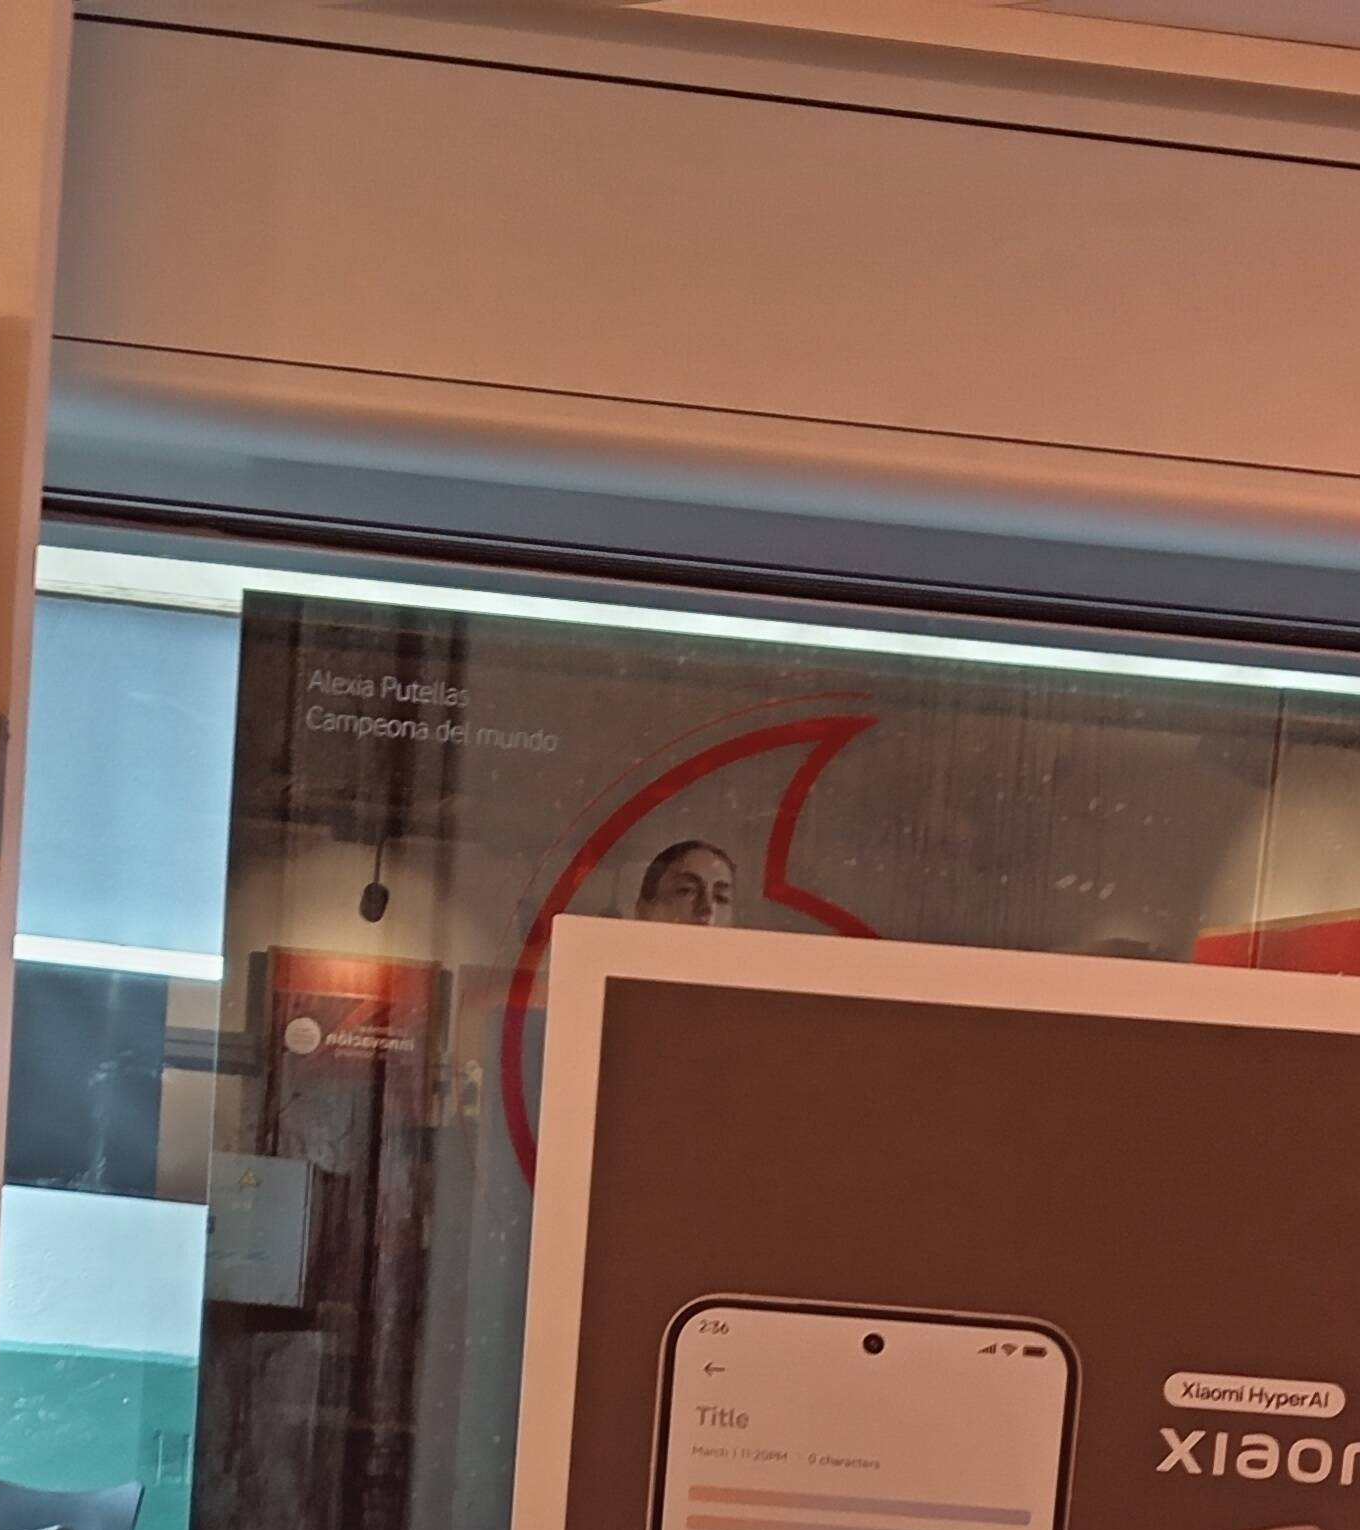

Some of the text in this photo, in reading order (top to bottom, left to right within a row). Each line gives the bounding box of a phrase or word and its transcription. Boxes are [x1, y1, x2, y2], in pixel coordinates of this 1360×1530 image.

[307, 669, 471, 709] Alexia Putellas
[306, 705, 559, 753] Campeona del mundo
[1181, 1381, 1330, 1411] Xiaomi HyperAI
[695, 1405, 750, 1430] Title
